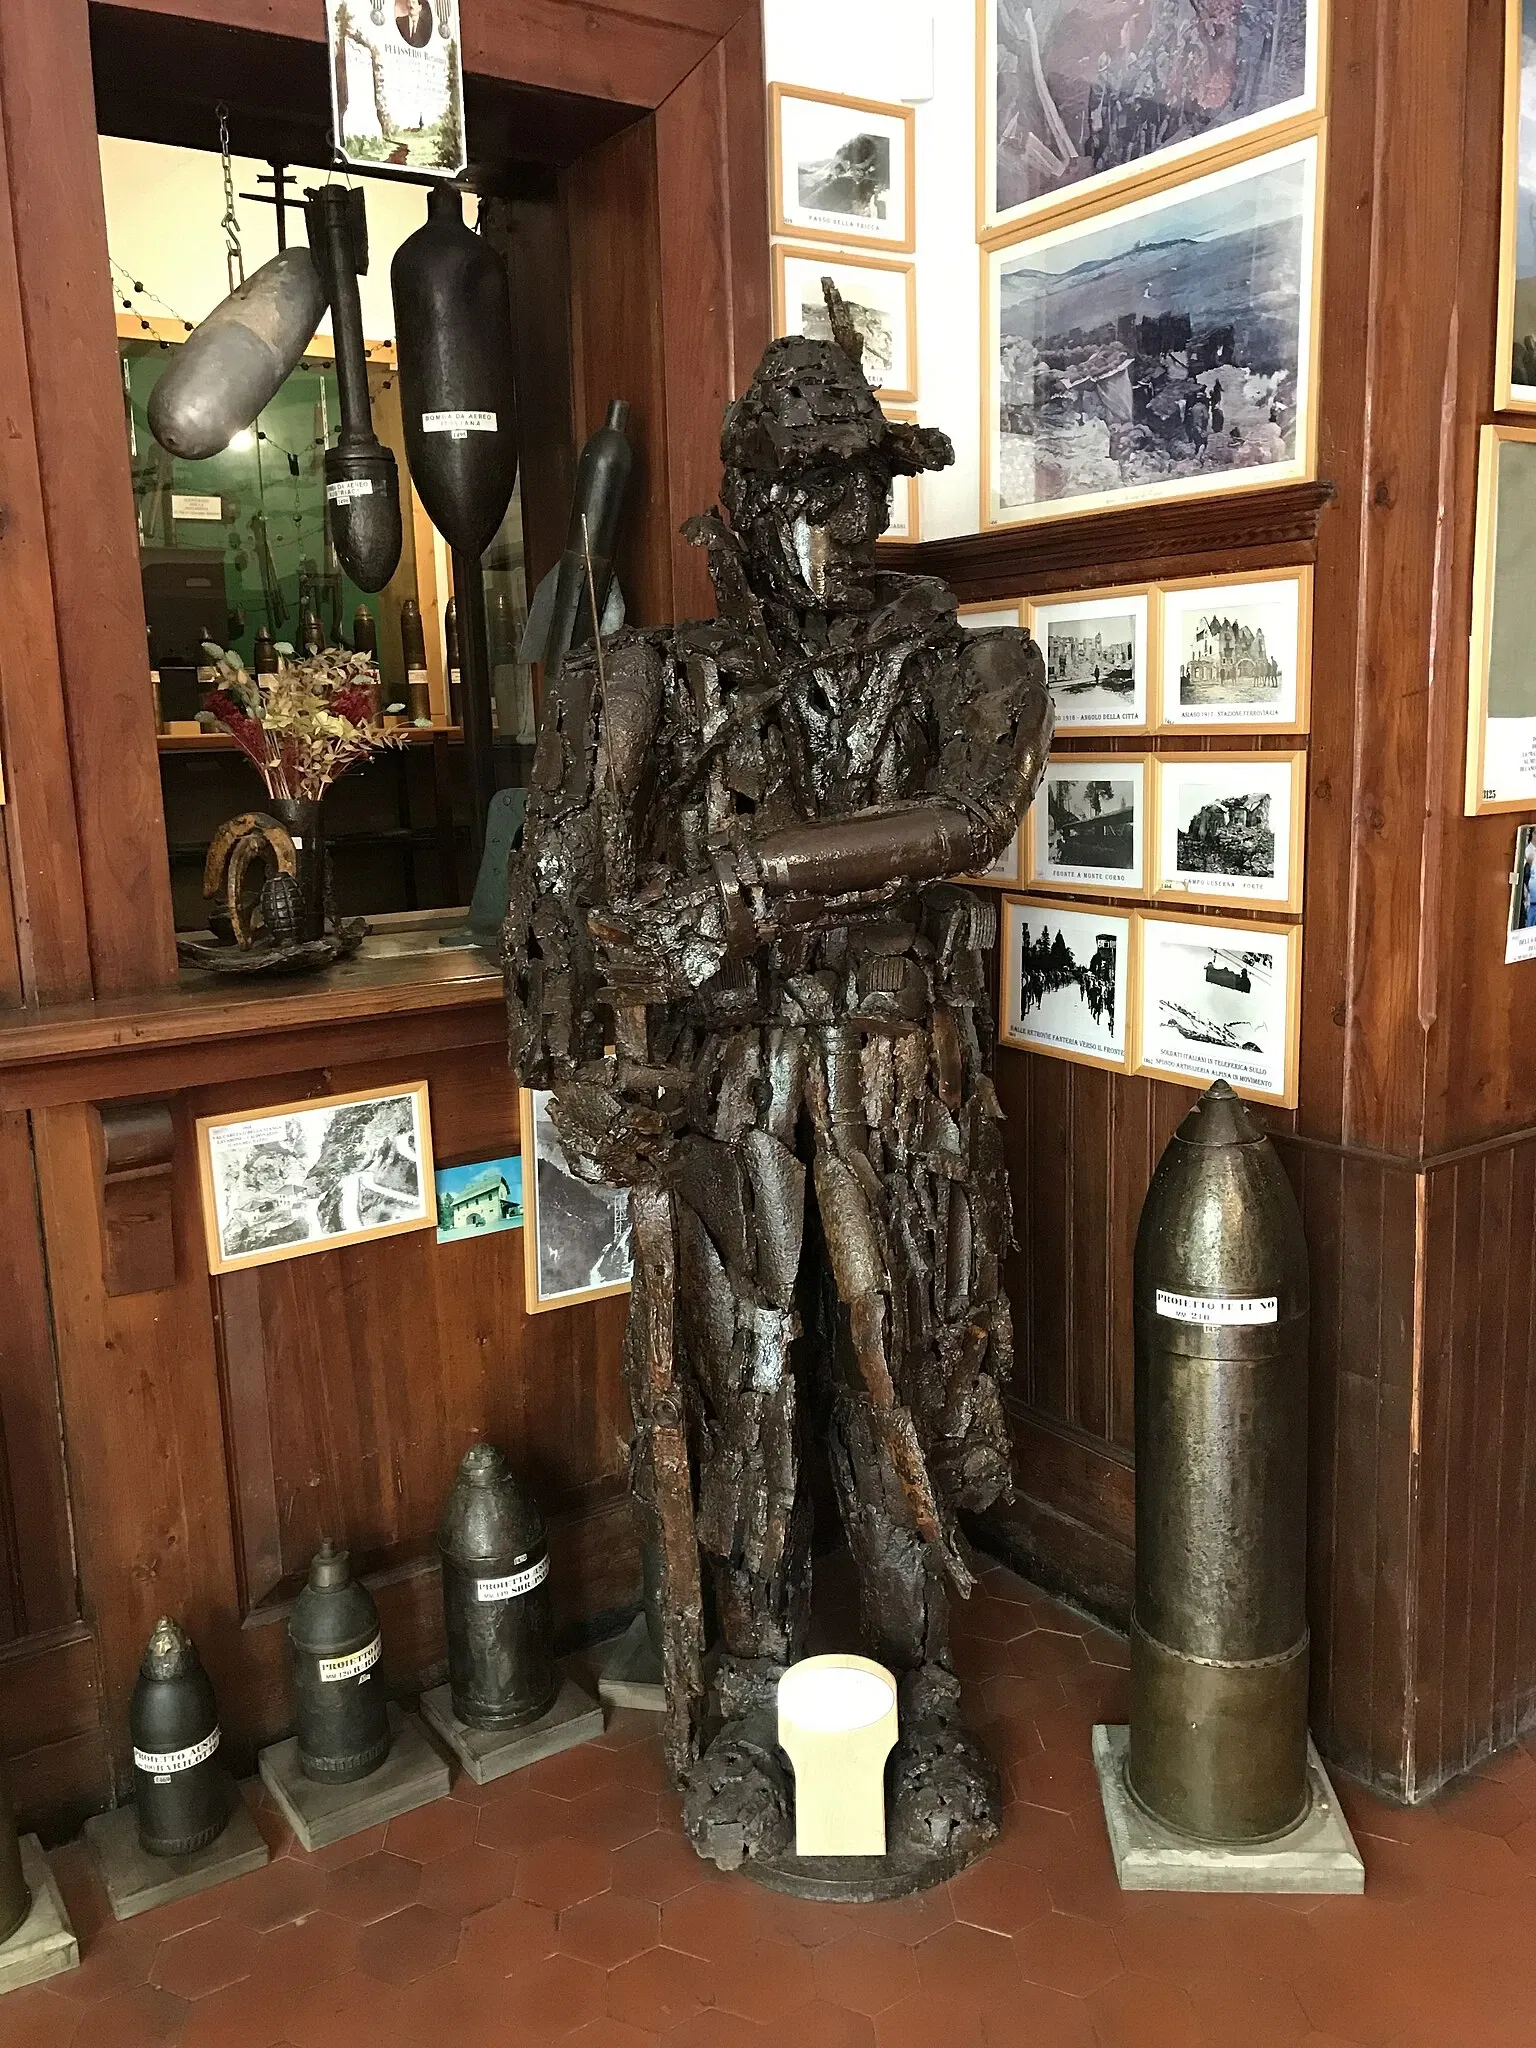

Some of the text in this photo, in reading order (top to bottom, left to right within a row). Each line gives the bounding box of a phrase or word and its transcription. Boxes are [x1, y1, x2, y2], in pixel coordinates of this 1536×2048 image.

[833, 218, 853, 227] DELLA
[1053, 870, 1075, 878] FRONTE
[1083, 872, 1103, 880] MONTE
[1010, 1025, 1027, 1035] DALLE
[1027, 1029, 1052, 1040] RETROVIE
[1052, 1034, 1079, 1047] FANTERIA
[1079, 1040, 1097, 1050] VERSO
[1103, 1045, 1124, 1056] FRONTE
[1160, 1048, 1183, 1059] SOLDATI
[1183, 1053, 1207, 1064] ITALIANI
[1214, 1059, 1248, 1072] TELEFERICA
[1248, 1066, 1267, 1076] SULLO
[1211, 1068, 1232, 1080] ALPINA
[1239, 1074, 1273, 1088] MOVIMENTO
[322, 1647, 373, 1671] PROIETTO
